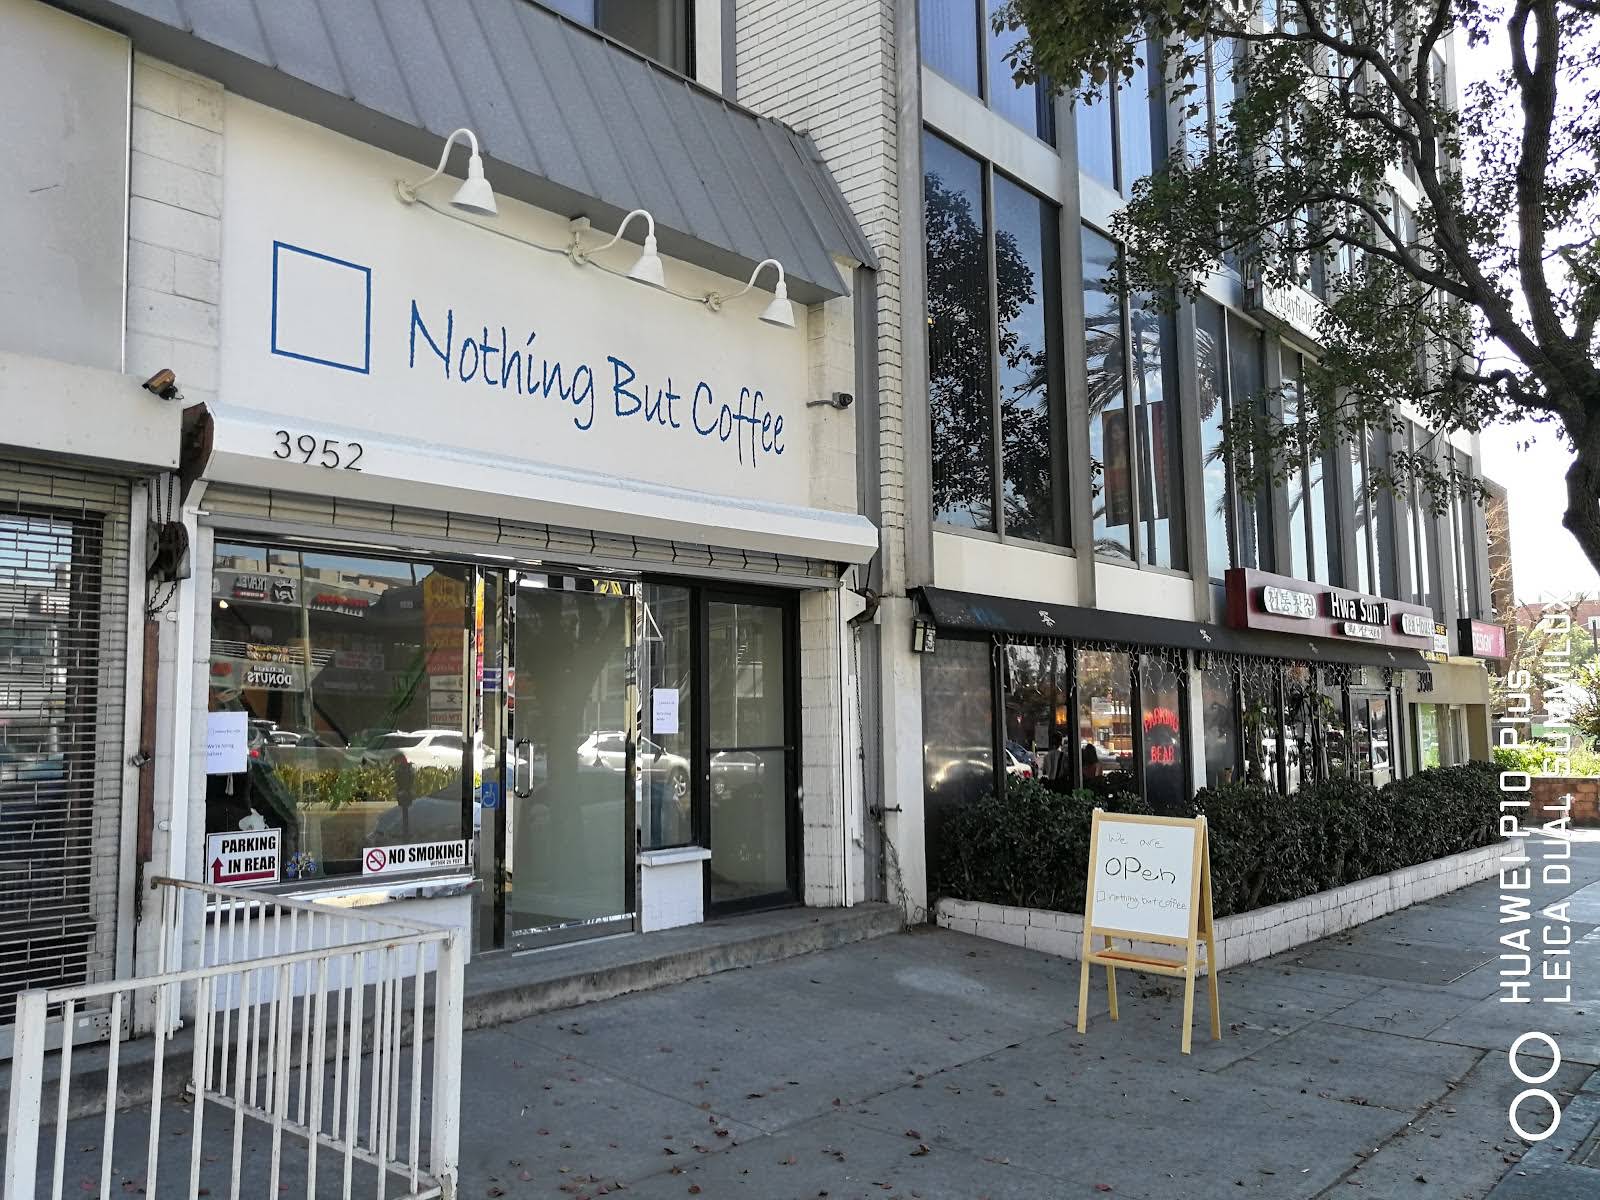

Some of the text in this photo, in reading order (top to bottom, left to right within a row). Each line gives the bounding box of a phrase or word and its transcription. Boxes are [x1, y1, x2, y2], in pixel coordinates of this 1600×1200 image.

[409, 299, 784, 468] Nothing But Coffee
[273, 430, 362, 471] 3952
[1330, 592, 1357, 620] Hwa
[1360, 597, 1380, 625] Sun
[1404, 615, 1415, 633] Tea
[1143, 706, 1179, 733] PARKING
[221, 835, 276, 854] PARKING
[388, 843, 463, 865] NO SMOKING
[1140, 839, 1164, 849] are
[228, 855, 276, 874] IN REAR
